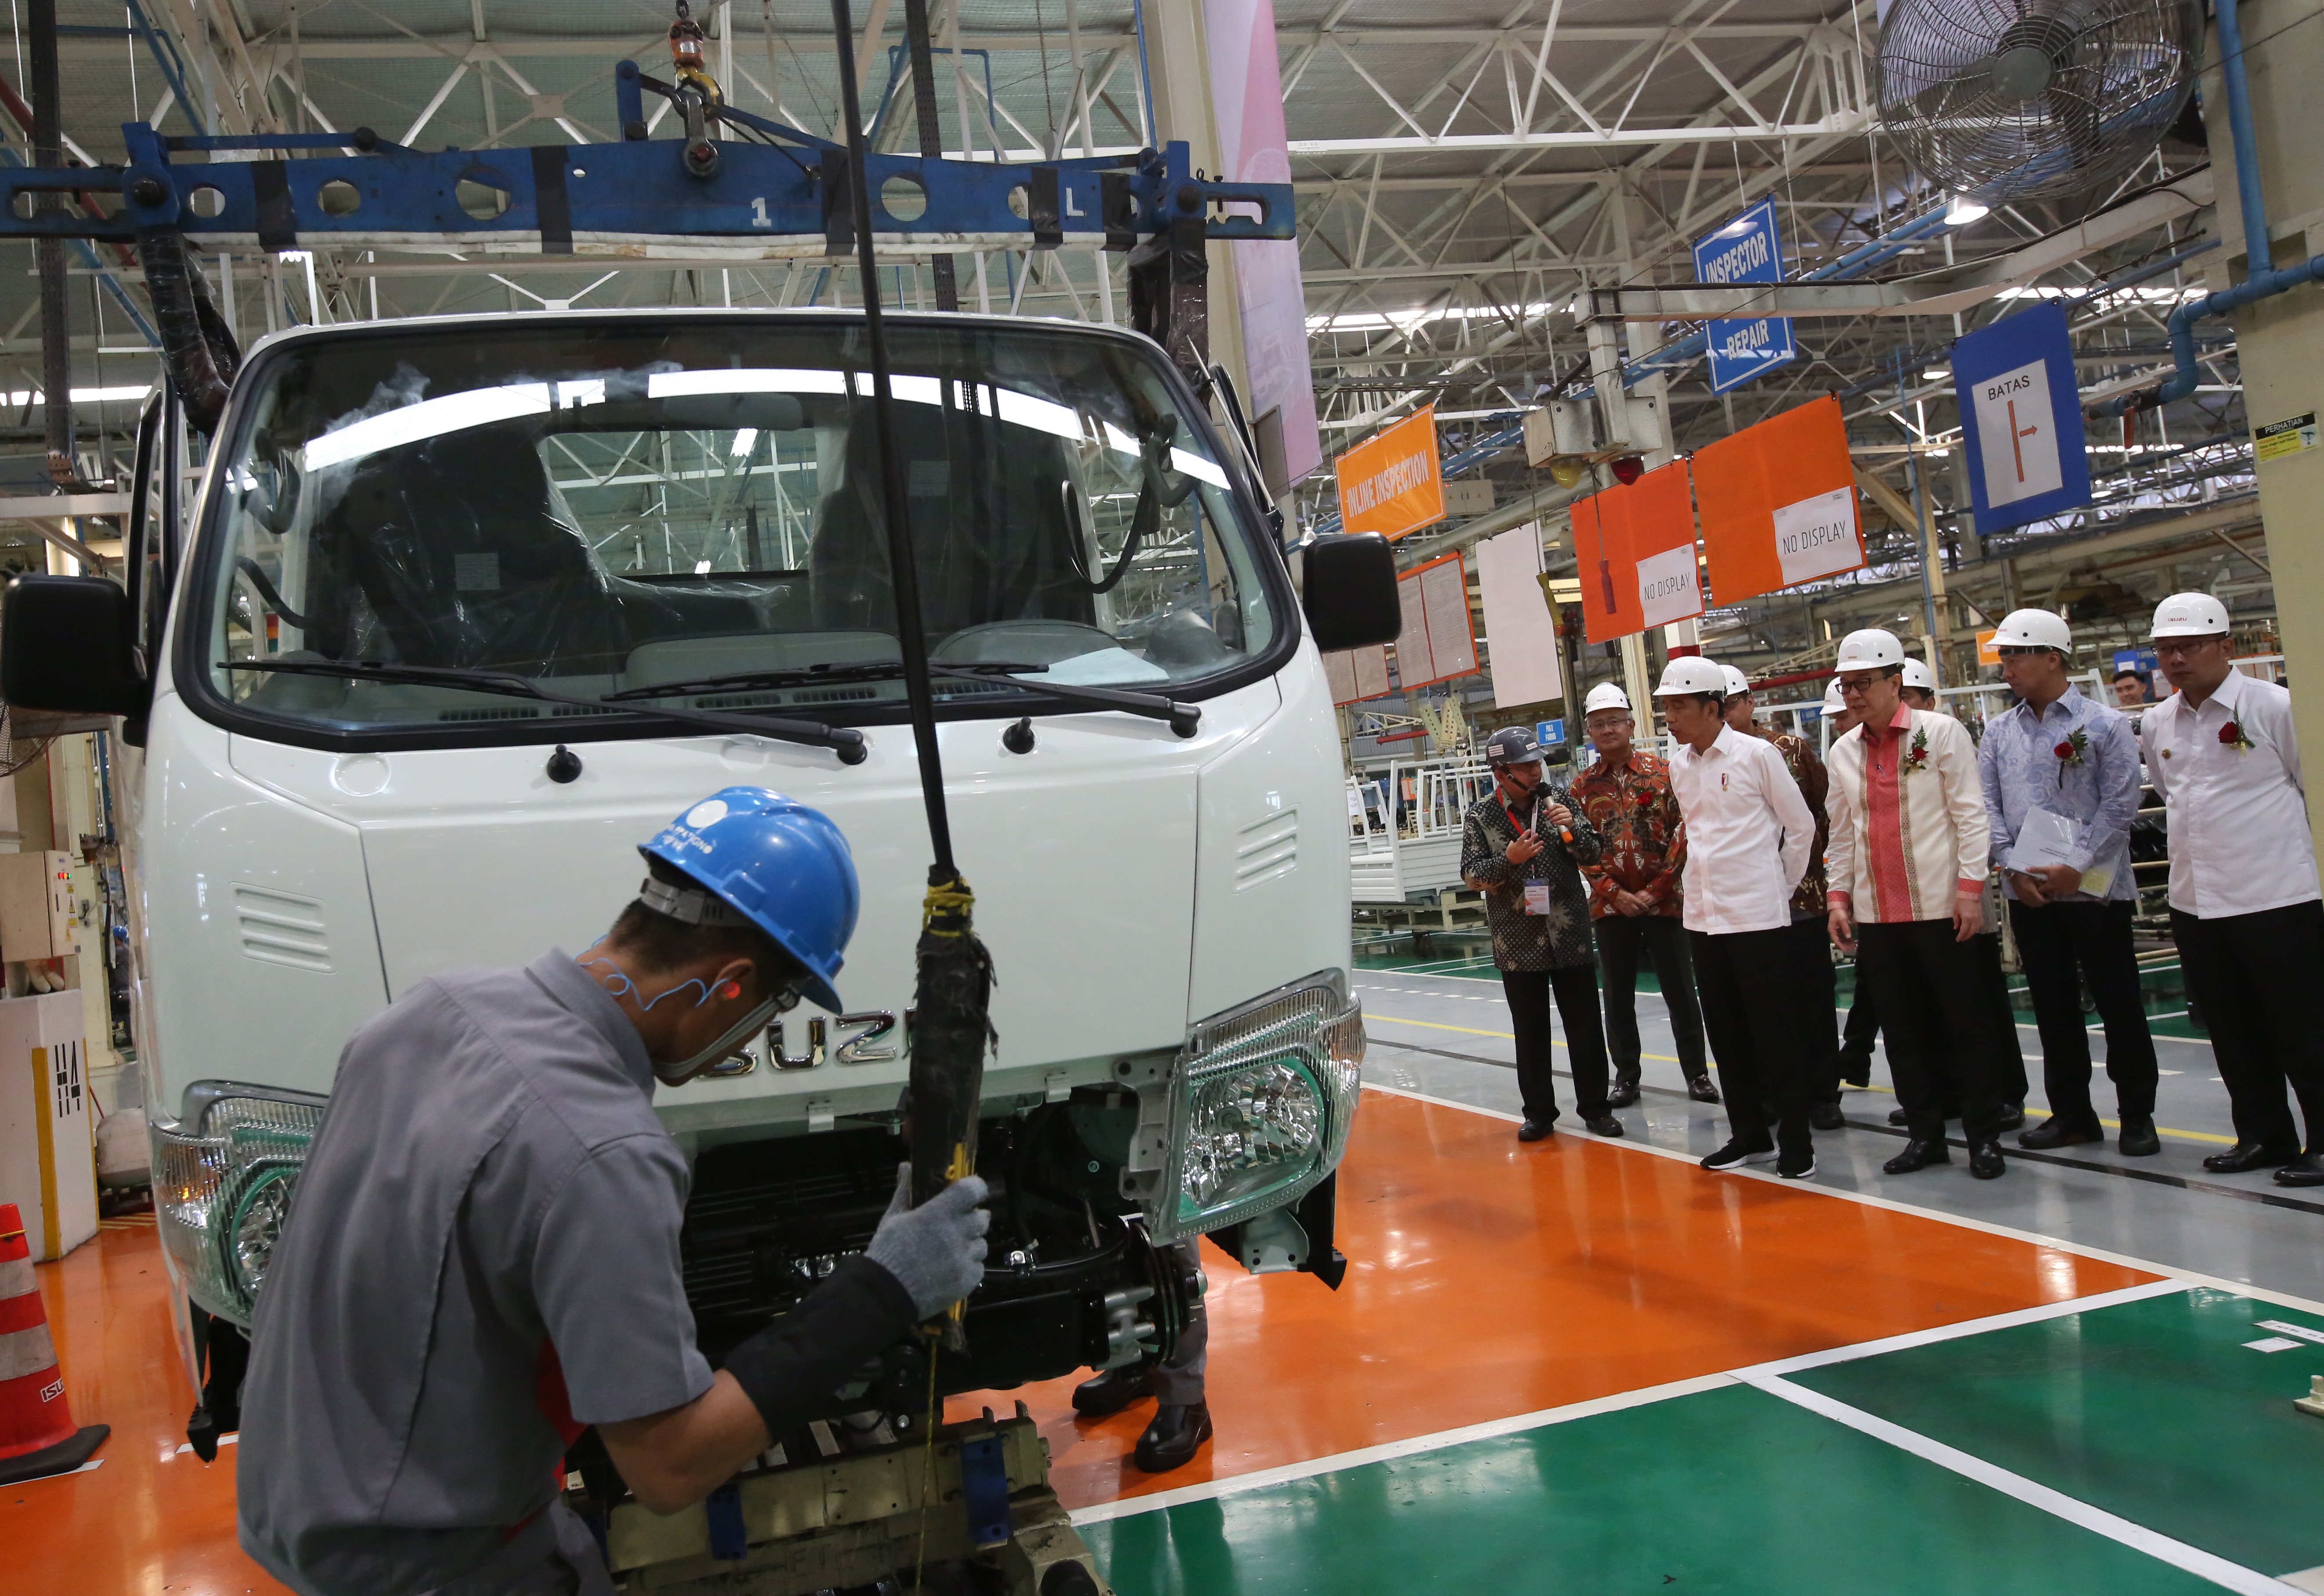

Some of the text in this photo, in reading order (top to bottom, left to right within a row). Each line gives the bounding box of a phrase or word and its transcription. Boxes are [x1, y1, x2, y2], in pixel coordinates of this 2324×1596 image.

[752, 197, 771, 226] 1
[1066, 187, 1086, 216] L
[1705, 231, 1769, 283] INSPECTOR
[1726, 319, 1769, 360] REPAIR
[1988, 375, 2030, 400] BATAS
[2265, 417, 2303, 434] PERHATIAN
[1347, 450, 1429, 518] INLINE INSPECTION
[1783, 520, 1845, 555] NO DISPLAY
[1644, 572, 1690, 601] NO DISPLAY
